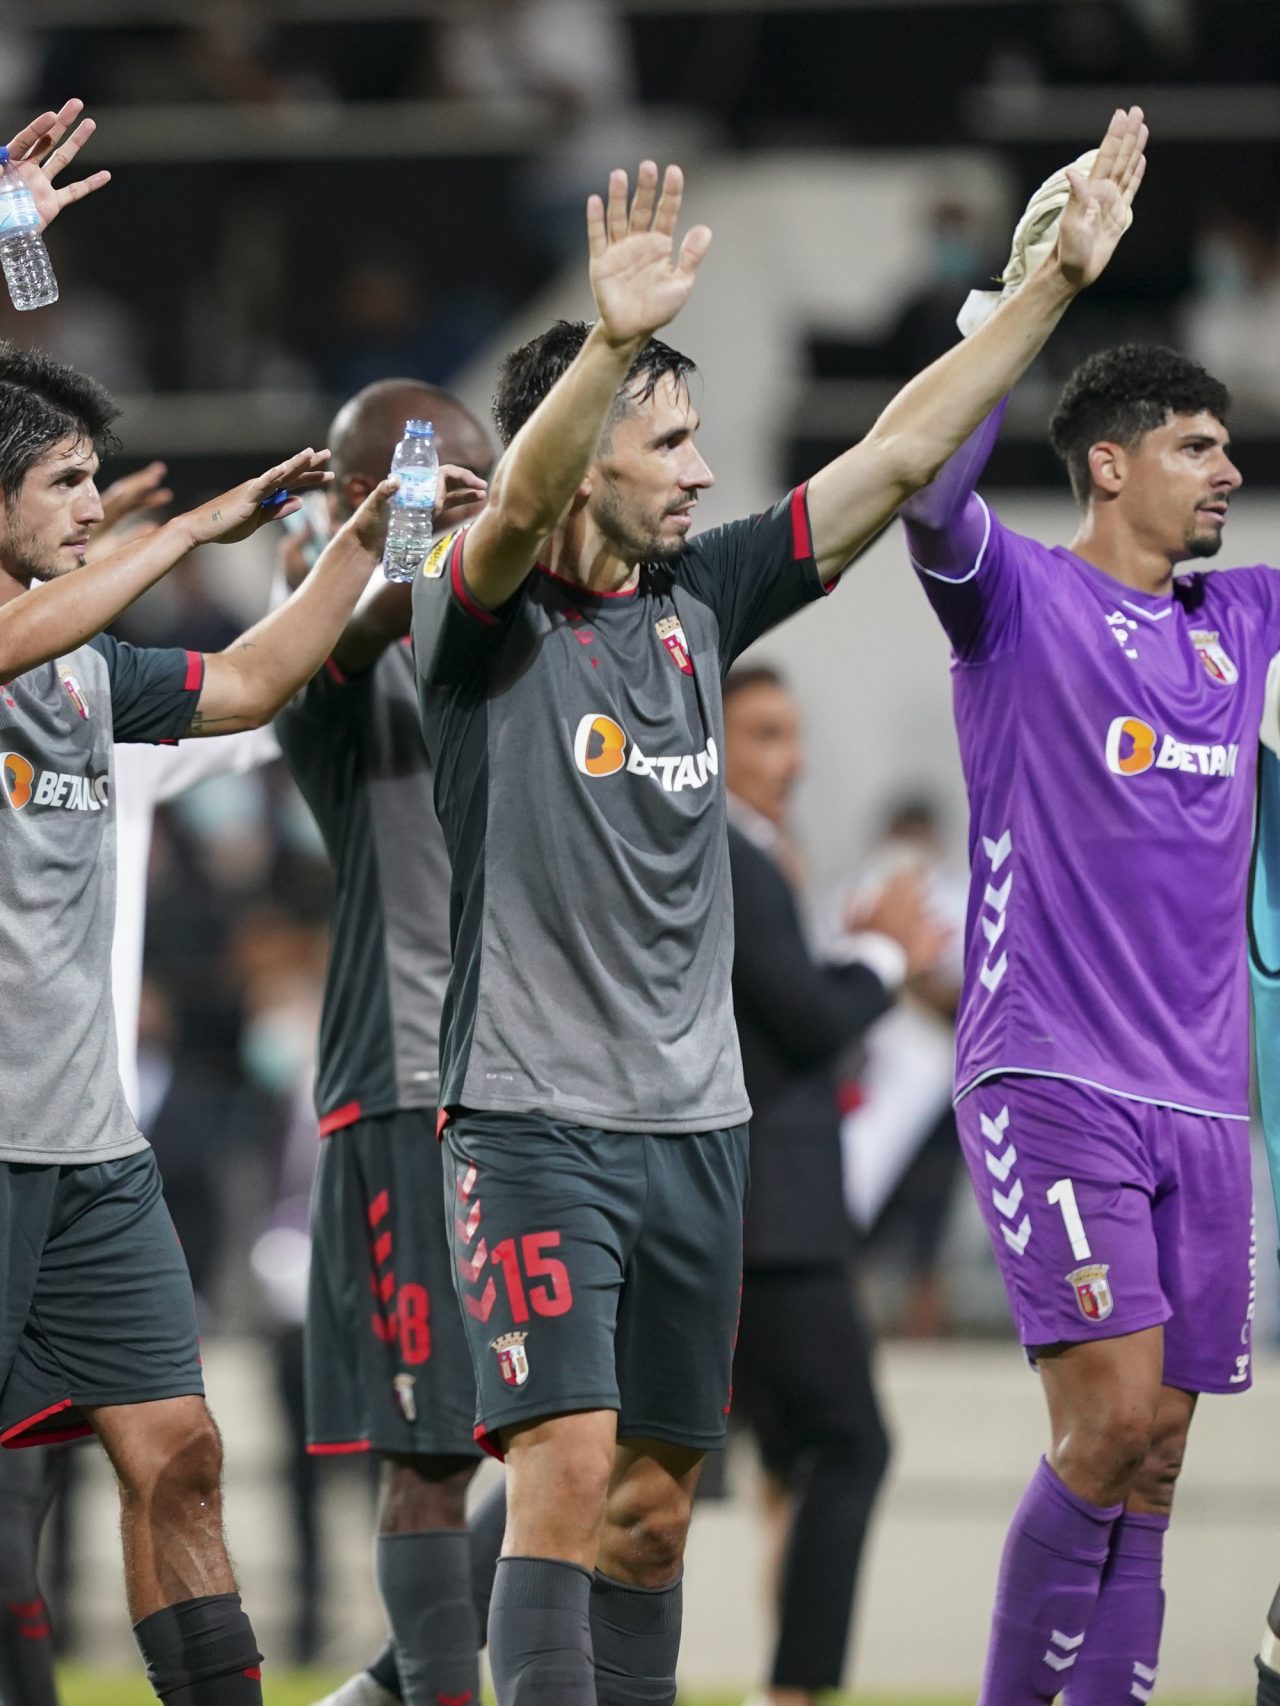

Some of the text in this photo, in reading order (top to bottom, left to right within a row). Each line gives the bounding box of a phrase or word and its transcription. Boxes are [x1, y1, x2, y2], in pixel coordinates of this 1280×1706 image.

[1046, 1178, 1092, 1261] 1
[491, 1230, 573, 1324] 15
[396, 1282, 431, 1365] 8
